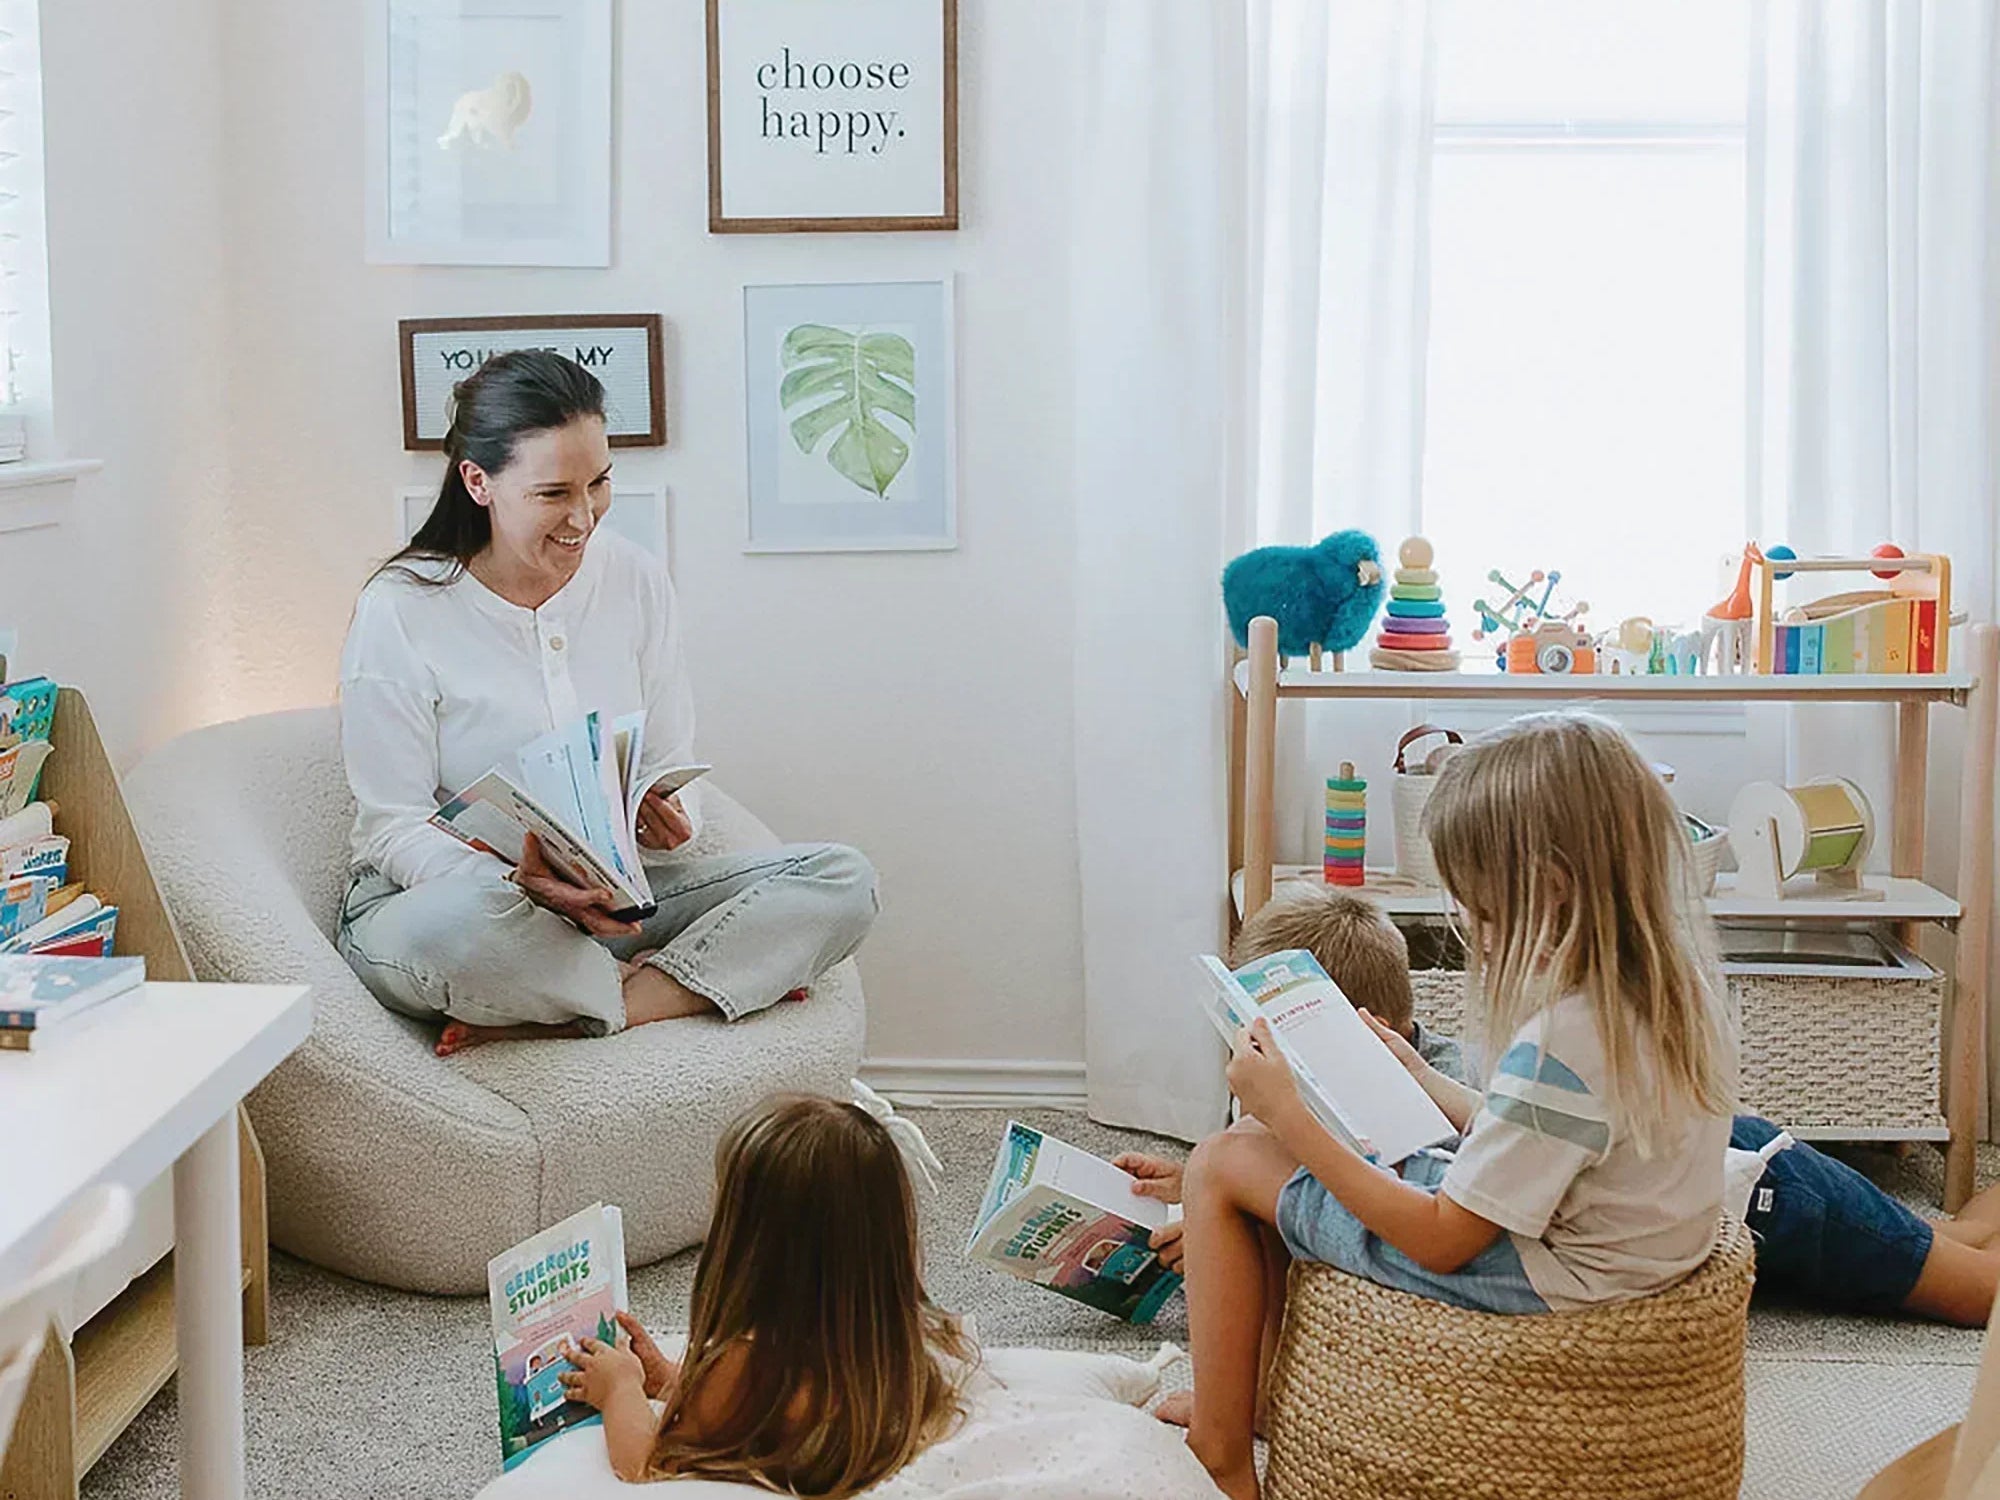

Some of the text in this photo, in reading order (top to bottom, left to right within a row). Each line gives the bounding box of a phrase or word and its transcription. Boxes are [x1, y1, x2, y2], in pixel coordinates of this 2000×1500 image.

[757, 46, 910, 90] choose
[760, 96, 906, 154] happy.
[575, 346, 613, 366] MY
[1005, 1202, 1067, 1257] GENEROUS
[1021, 1209, 1082, 1261] STUDENTS
[505, 1240, 590, 1297] GENEROUS
[509, 1261, 590, 1315] STUDENTS
